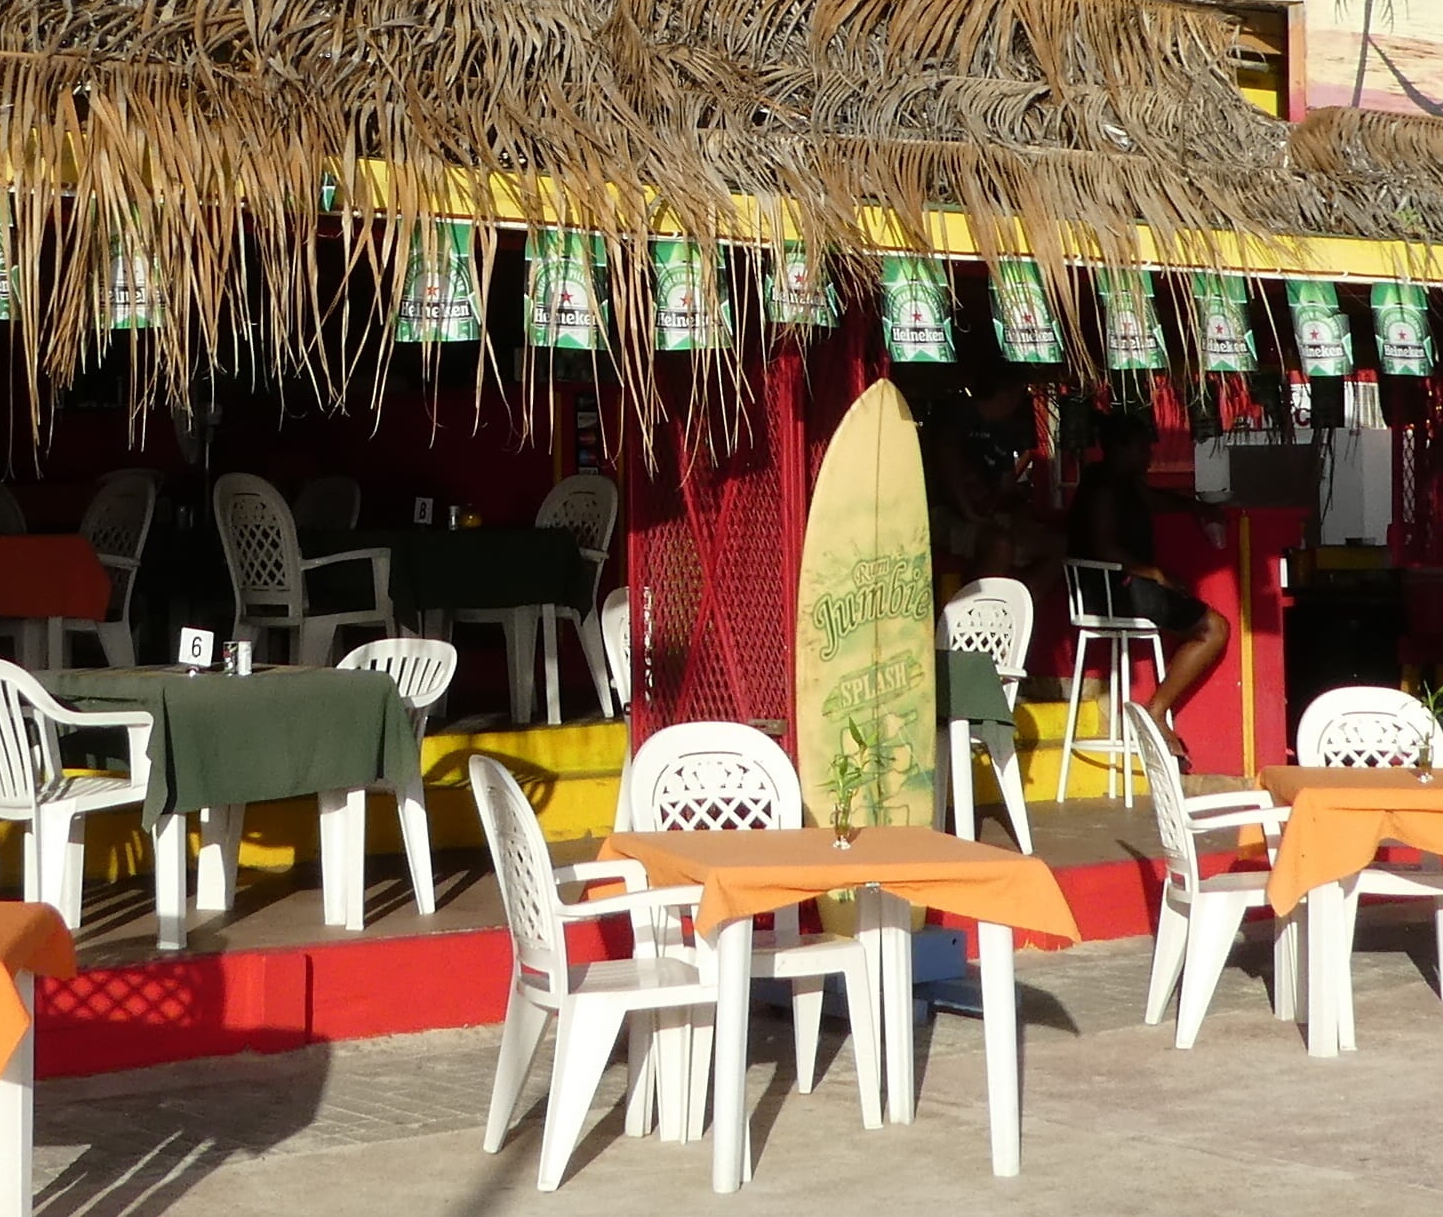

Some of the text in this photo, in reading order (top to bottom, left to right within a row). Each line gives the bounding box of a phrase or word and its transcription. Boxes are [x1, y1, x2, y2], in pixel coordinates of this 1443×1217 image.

[893, 328, 946, 342] Heineken
[1384, 343, 1426, 358] Heineken
[855, 557, 891, 586] Rum
[814, 566, 931, 662] Jumbie
[191, 636, 203, 658] 6
[839, 662, 909, 710] SPLASH
